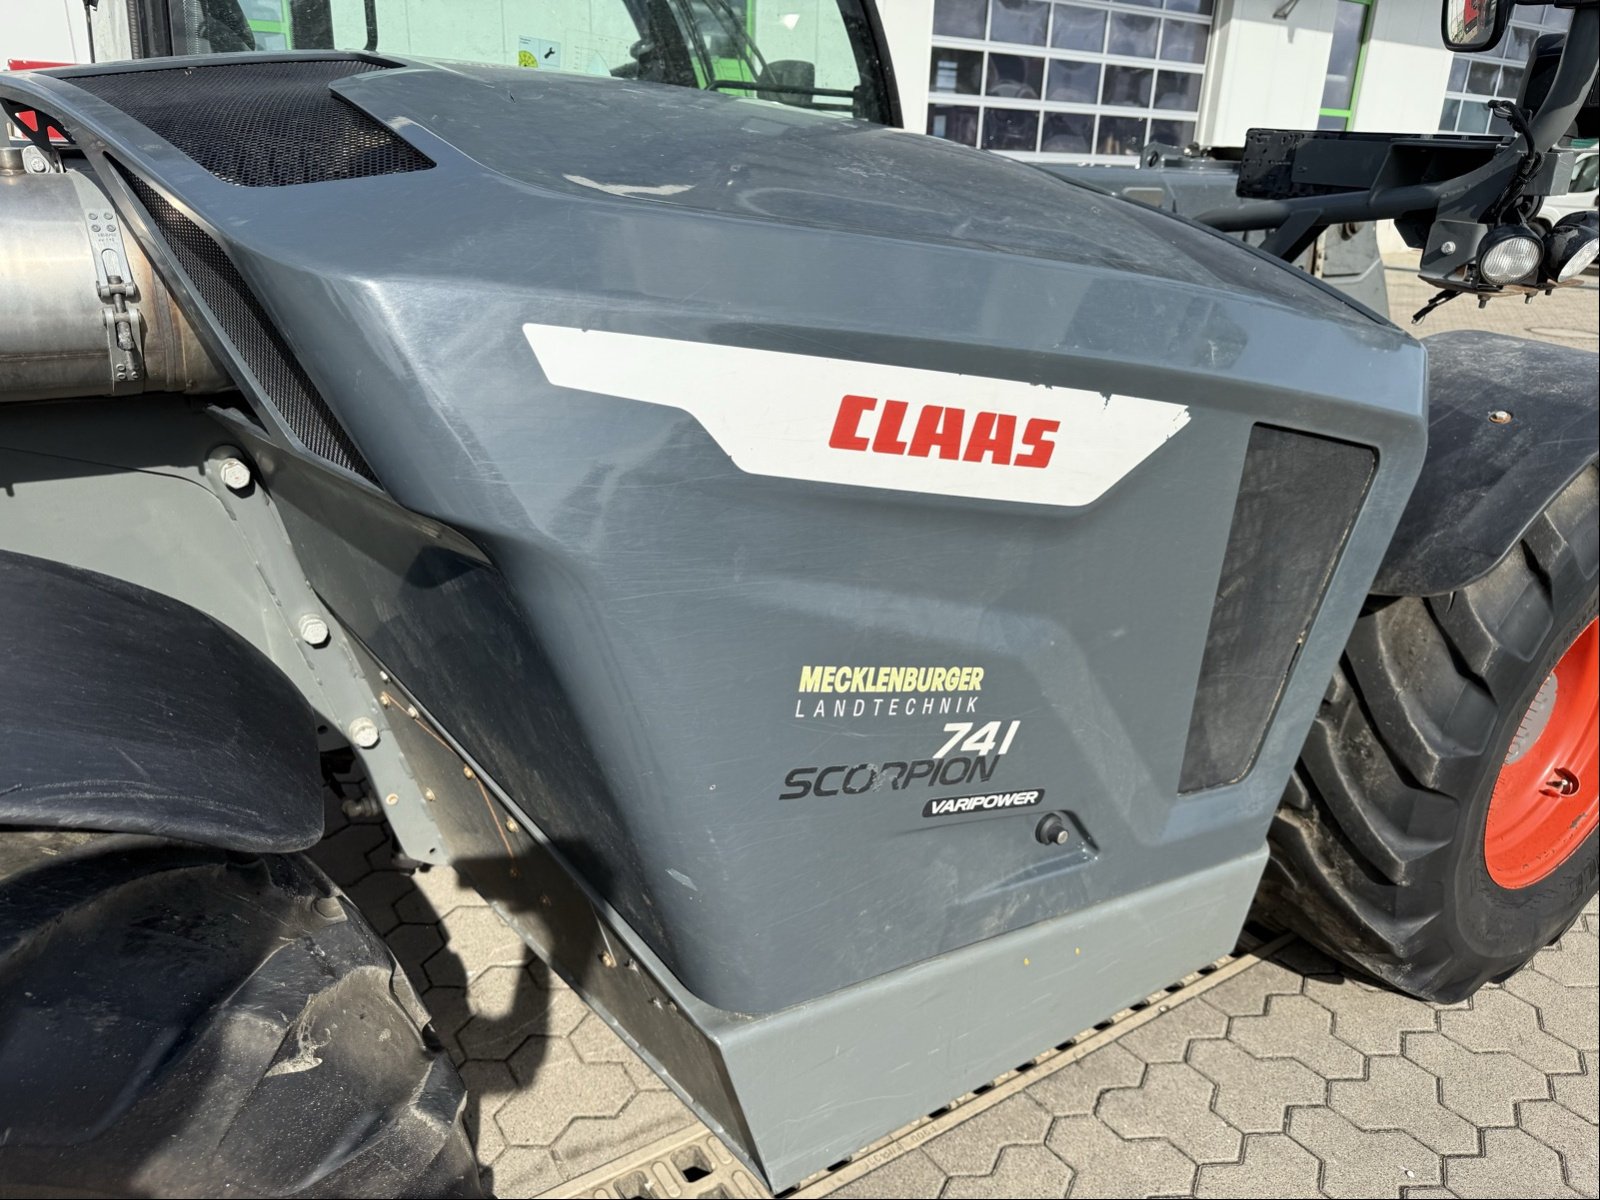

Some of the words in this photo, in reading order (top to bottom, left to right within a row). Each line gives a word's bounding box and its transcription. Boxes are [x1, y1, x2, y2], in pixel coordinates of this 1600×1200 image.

[829, 394, 1061, 469] CLAAS
[798, 666, 985, 693] MECKLENBURGER
[795, 696, 979, 718] LANDTECHNIK
[932, 720, 1021, 759] 741
[778, 754, 1001, 800] SCORPION
[931, 790, 1039, 815] VARIPOWER
